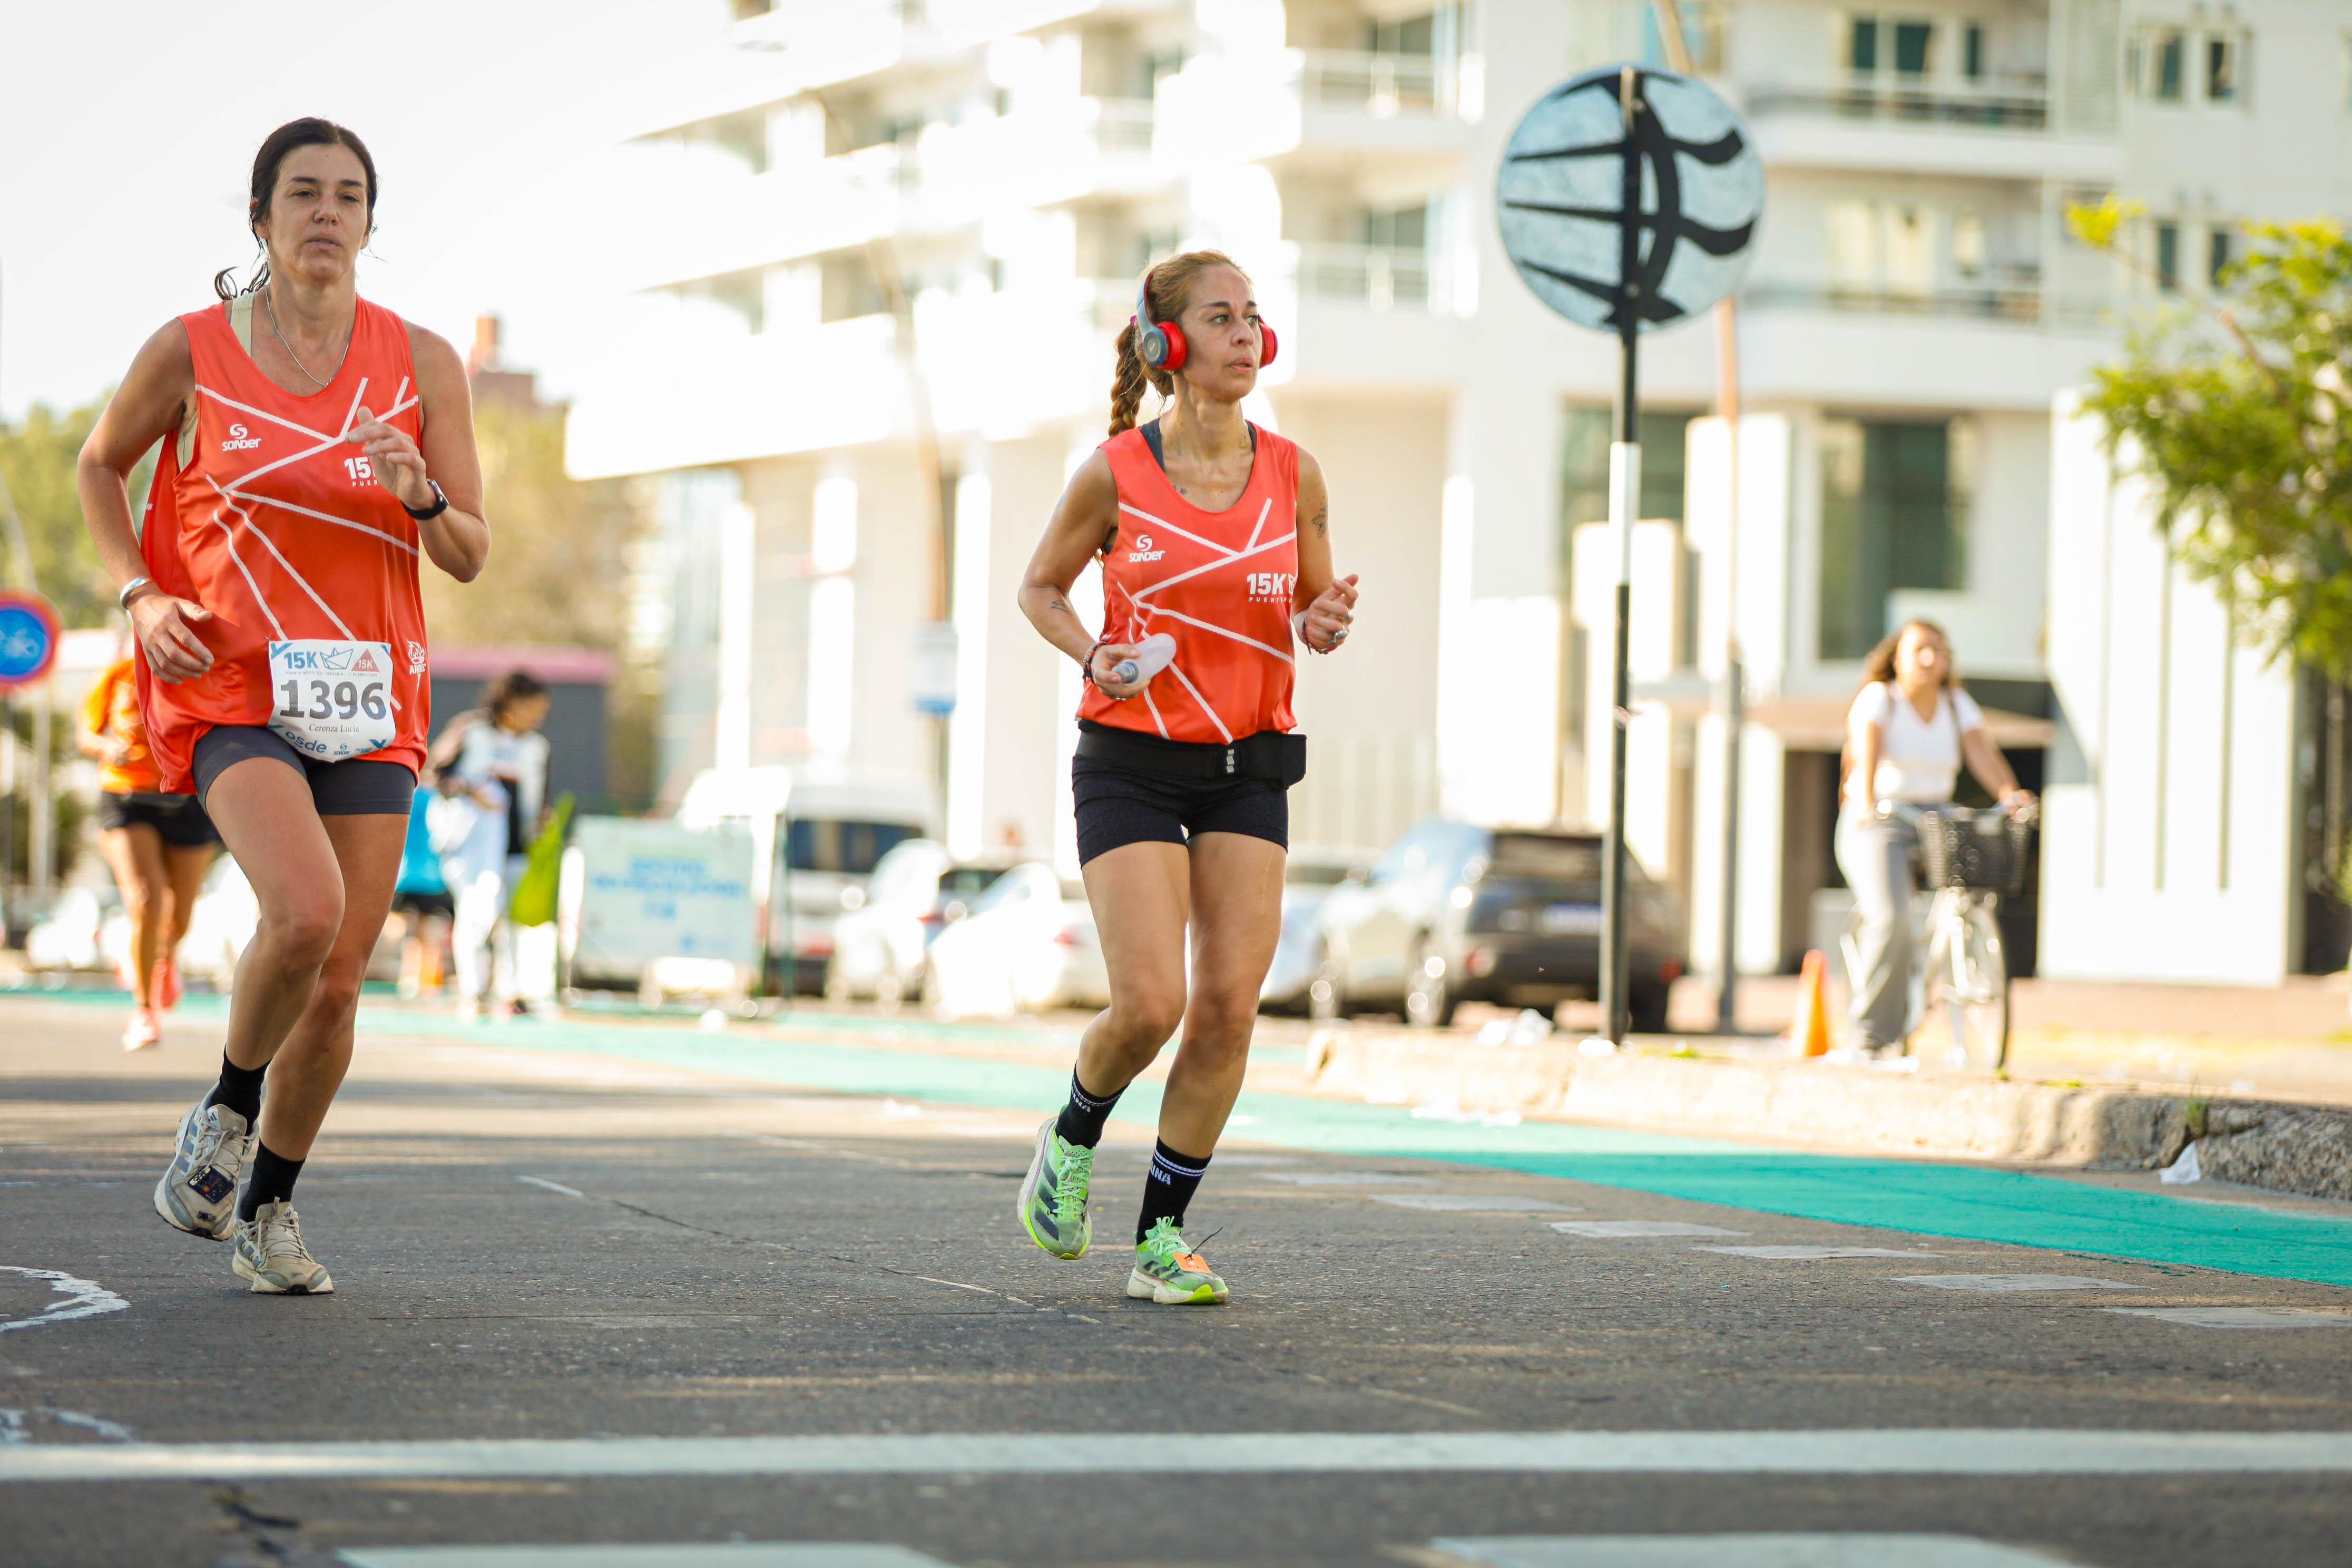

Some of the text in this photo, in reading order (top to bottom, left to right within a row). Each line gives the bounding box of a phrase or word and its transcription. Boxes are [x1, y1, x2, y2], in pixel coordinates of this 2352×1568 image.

[344, 456, 376, 479] 15
[1247, 573, 1287, 595] 15K
[284, 651, 318, 669] 15K
[358, 659, 373, 669] 15K
[409, 663, 427, 675] ARDEC
[280, 680, 387, 720] 1396
[285, 731, 327, 753] osde
